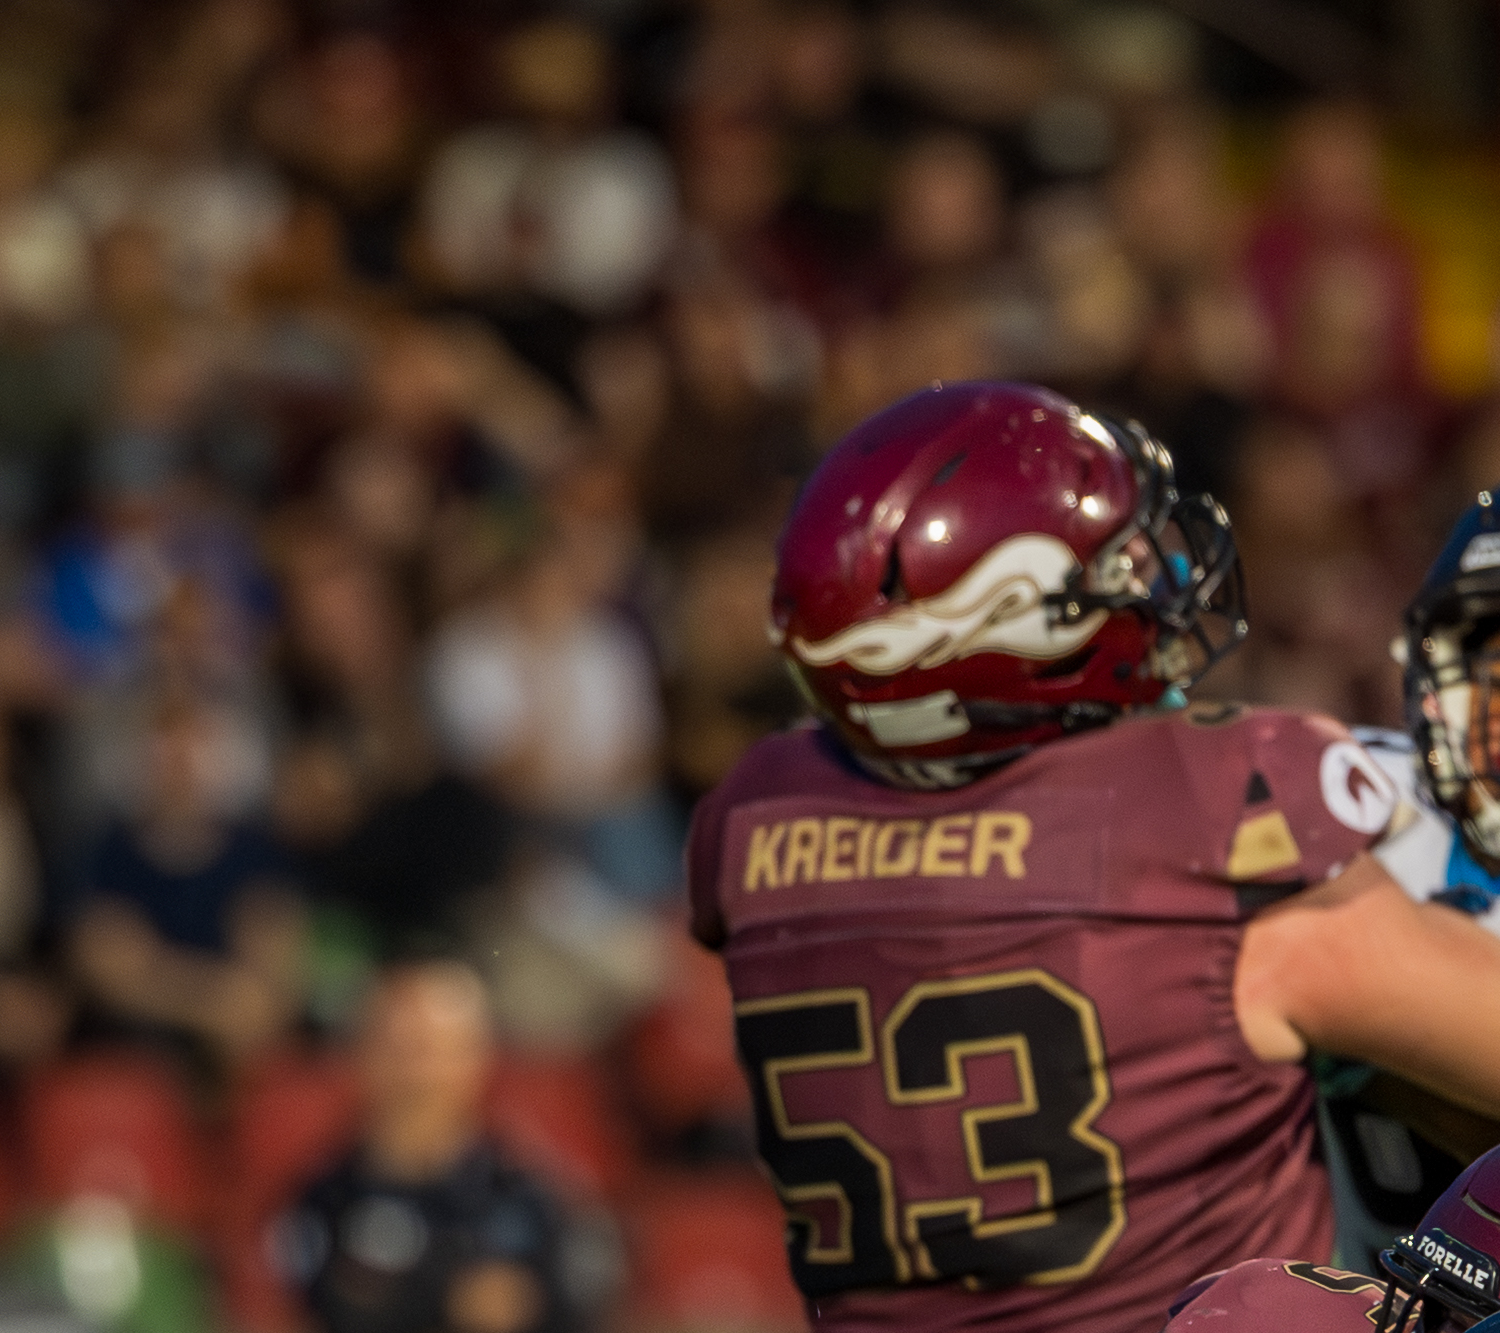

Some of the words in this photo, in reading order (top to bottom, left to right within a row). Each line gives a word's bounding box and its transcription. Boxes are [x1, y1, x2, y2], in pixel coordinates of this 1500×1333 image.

[745, 811, 1033, 892] KREIDER
[735, 968, 1127, 1292] 53
[1417, 1235, 1490, 1291] FORELLE
